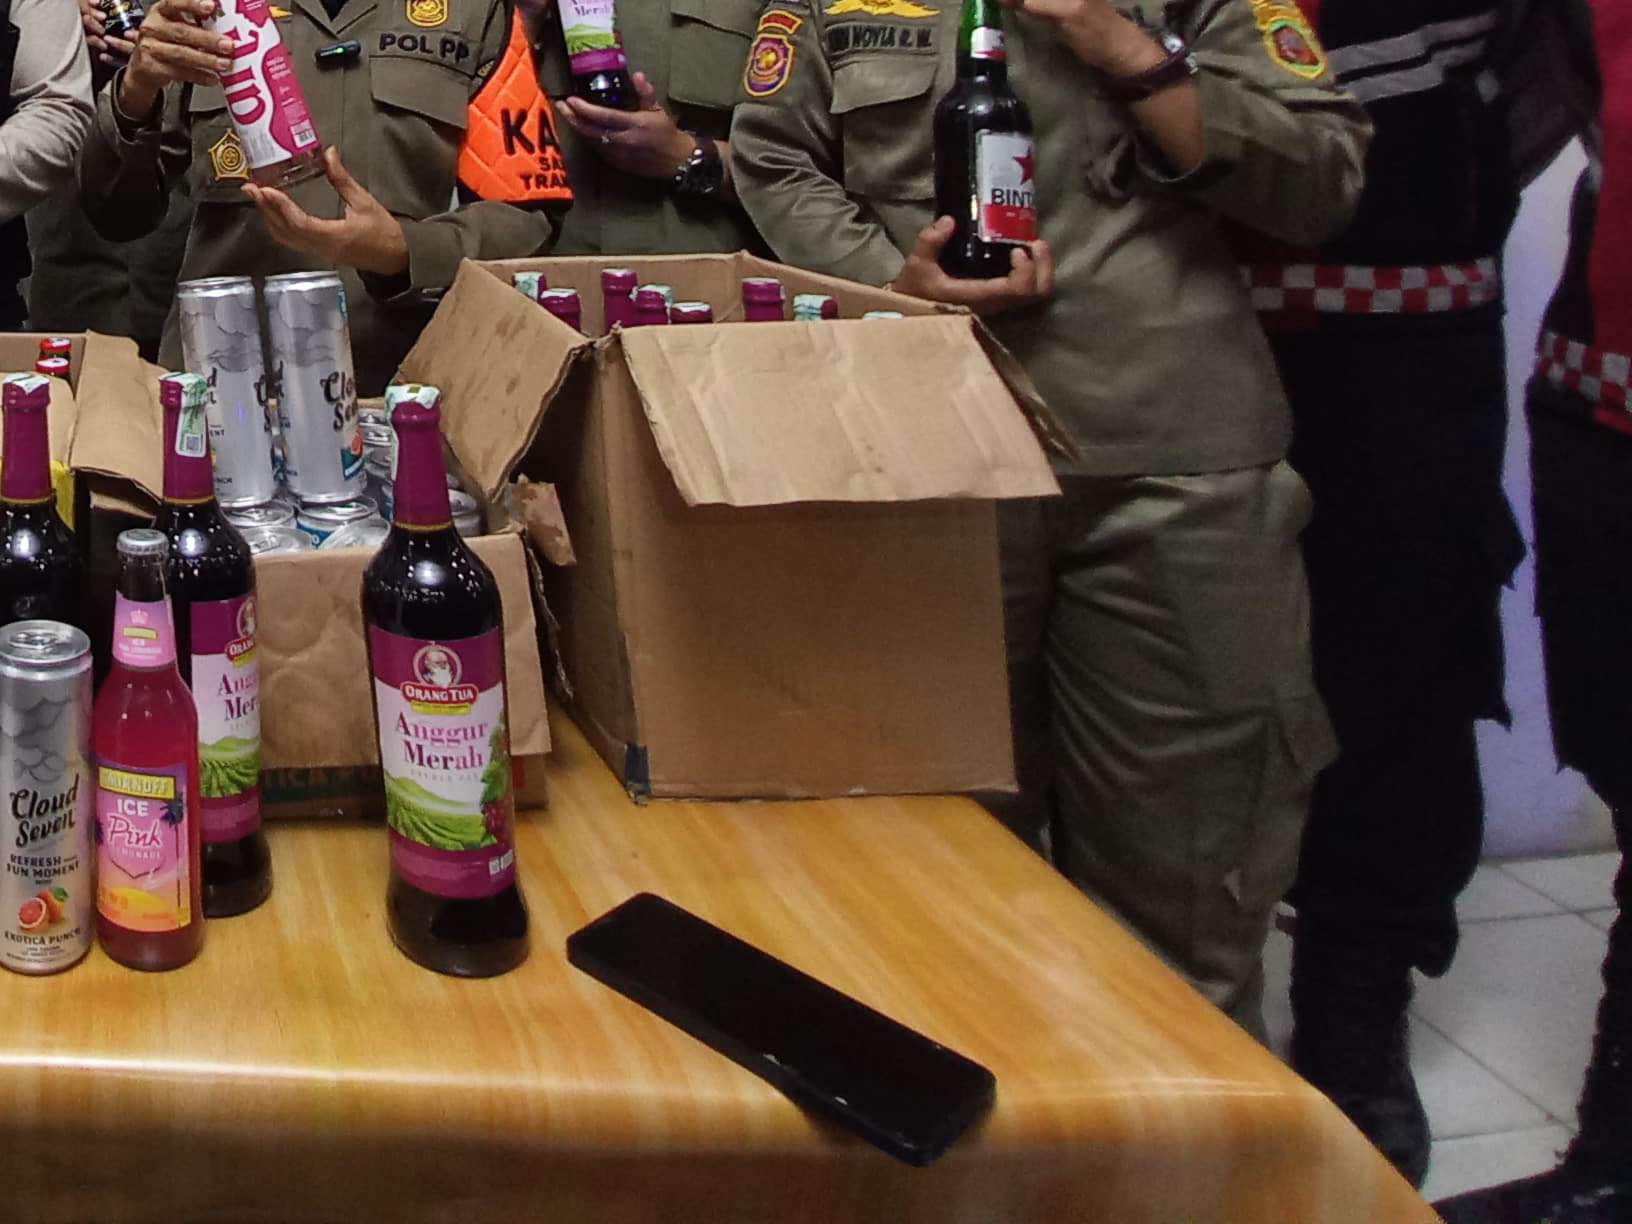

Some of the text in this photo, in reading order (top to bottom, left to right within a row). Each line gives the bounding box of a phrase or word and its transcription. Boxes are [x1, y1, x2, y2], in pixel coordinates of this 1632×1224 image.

[379, 33, 434, 53] POL
[405, 685, 474, 701] ORANG TUA
[395, 711, 488, 748] Anggur
[403, 739, 484, 770] Merah
[9, 773, 80, 819] Cloud
[117, 799, 149, 817] ICE
[16, 808, 76, 847] Seven
[108, 813, 163, 847] Pink
[10, 853, 61, 868] REFRESH
